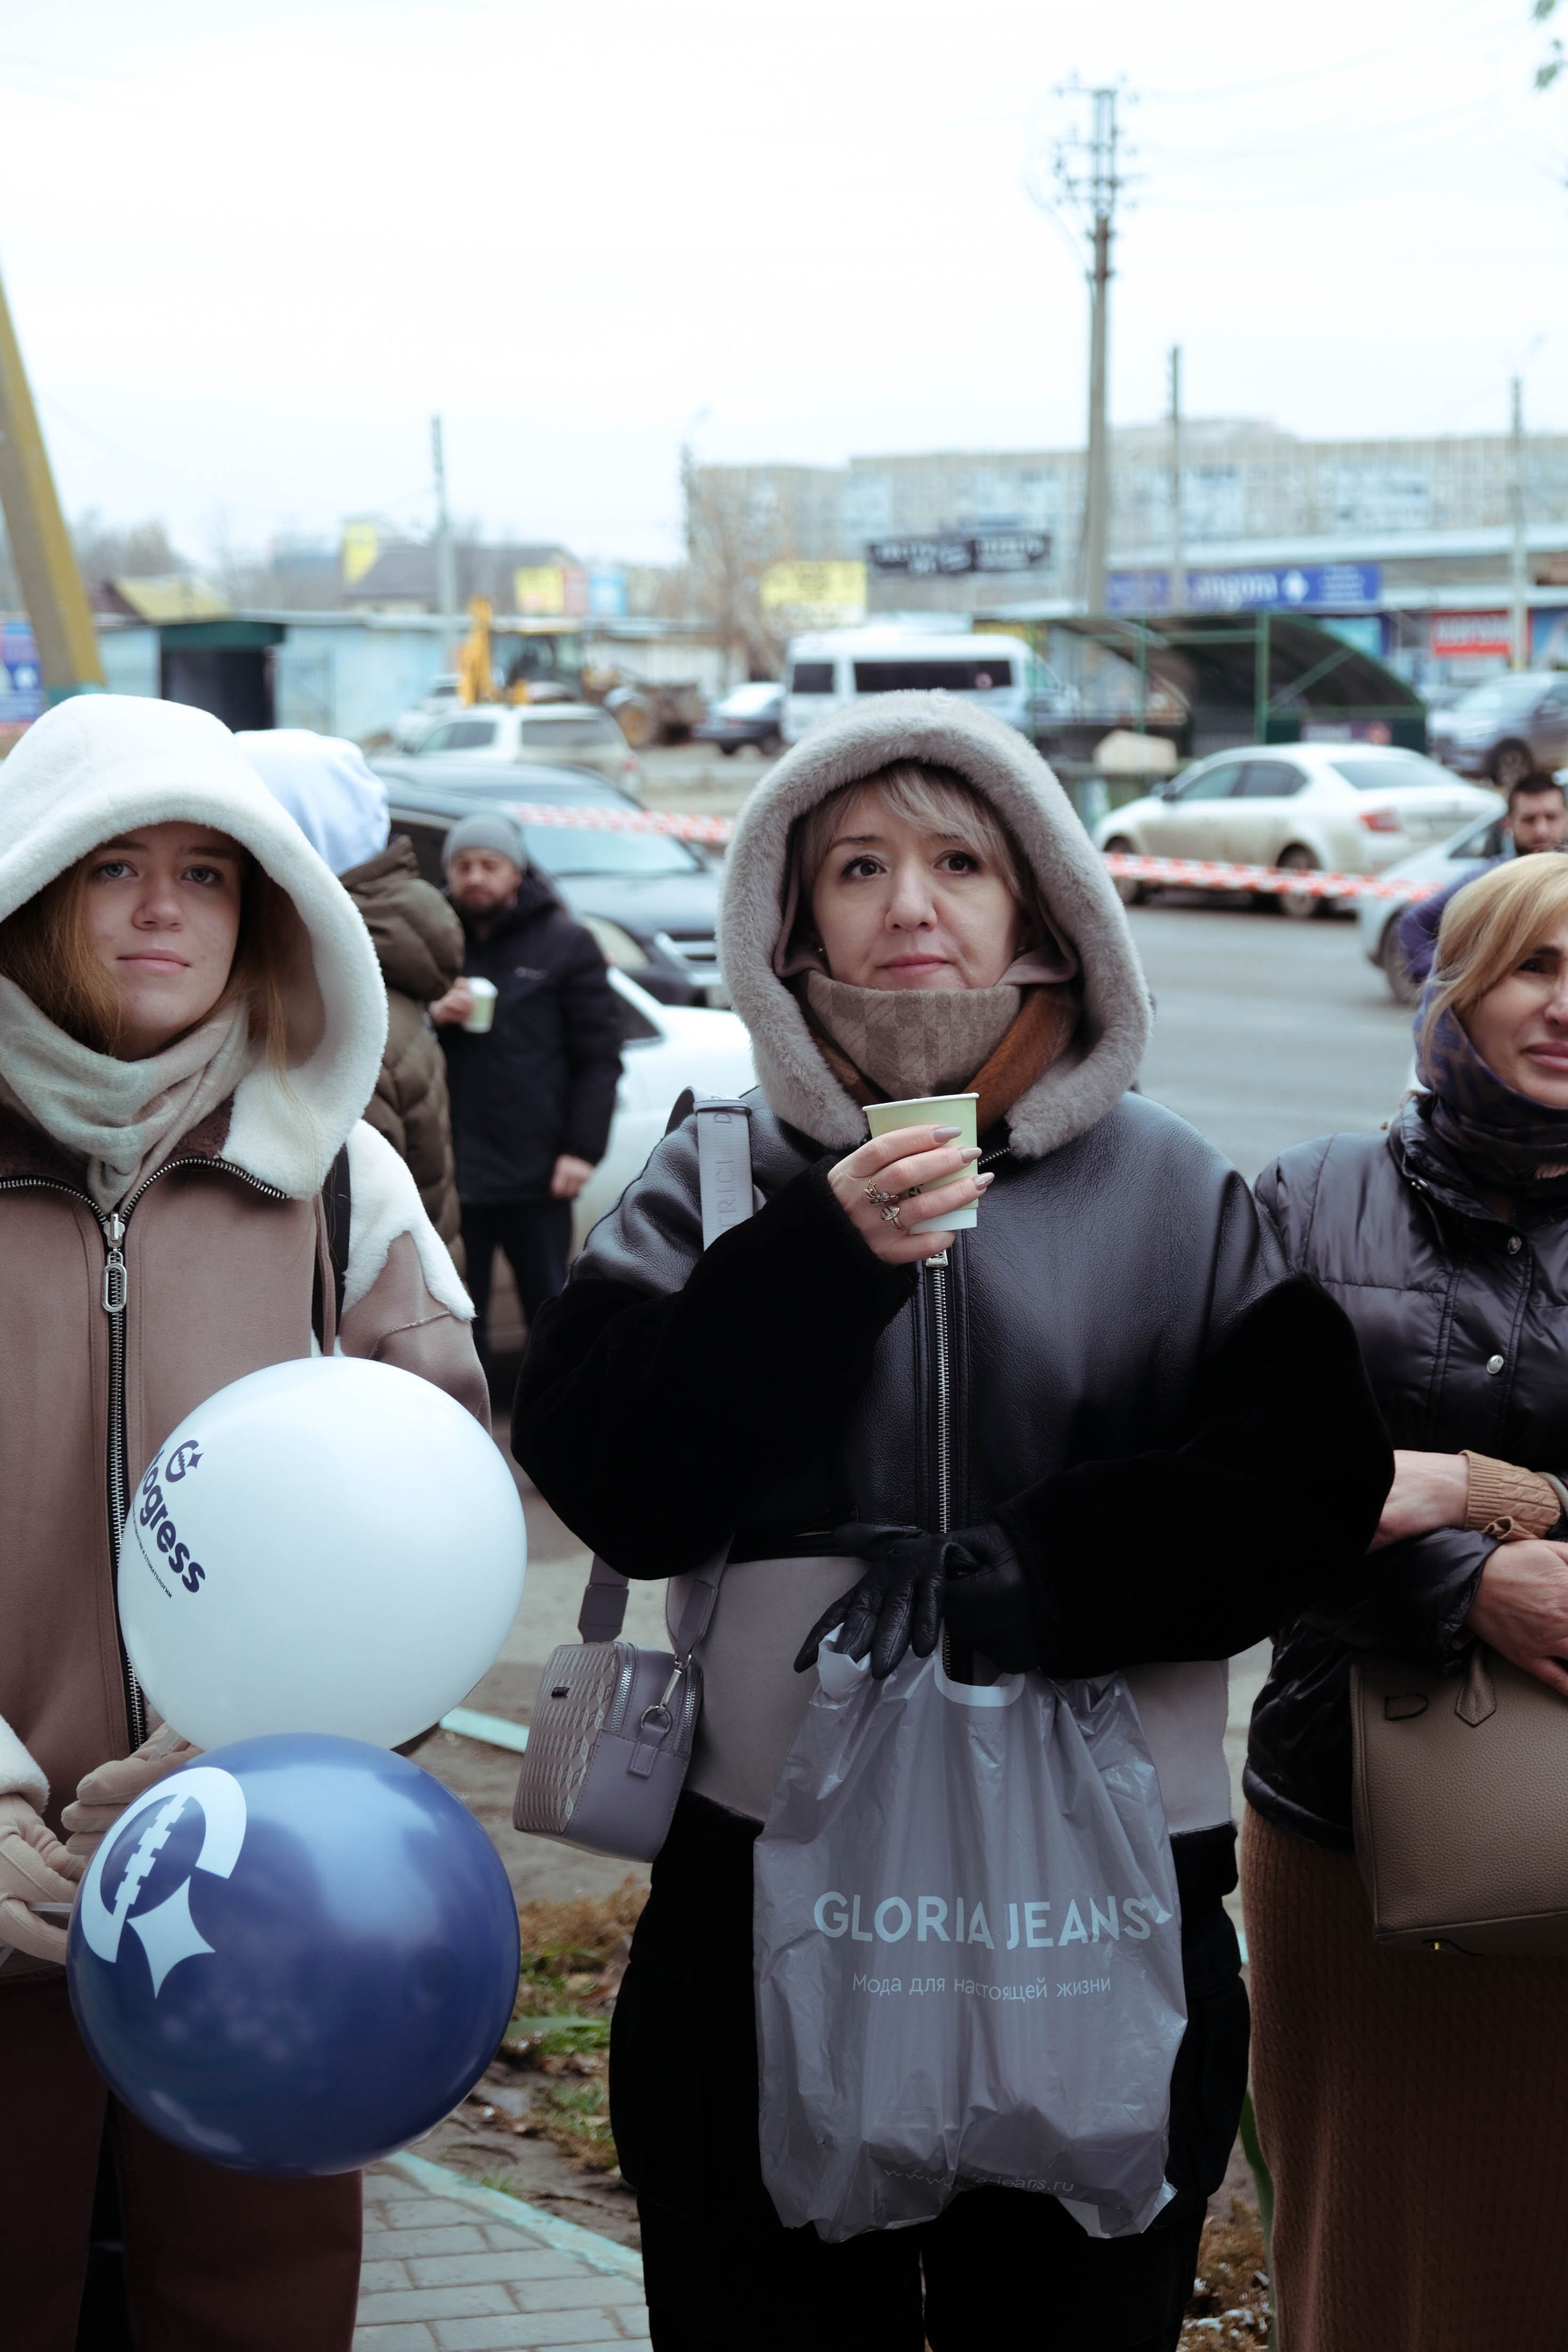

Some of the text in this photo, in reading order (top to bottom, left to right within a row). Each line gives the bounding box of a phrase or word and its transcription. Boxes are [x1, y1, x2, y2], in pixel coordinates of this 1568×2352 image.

[813, 1891, 1152, 1950] GLORIA JEANS
[853, 1972, 1111, 2003] Мода для настоящей жизни
